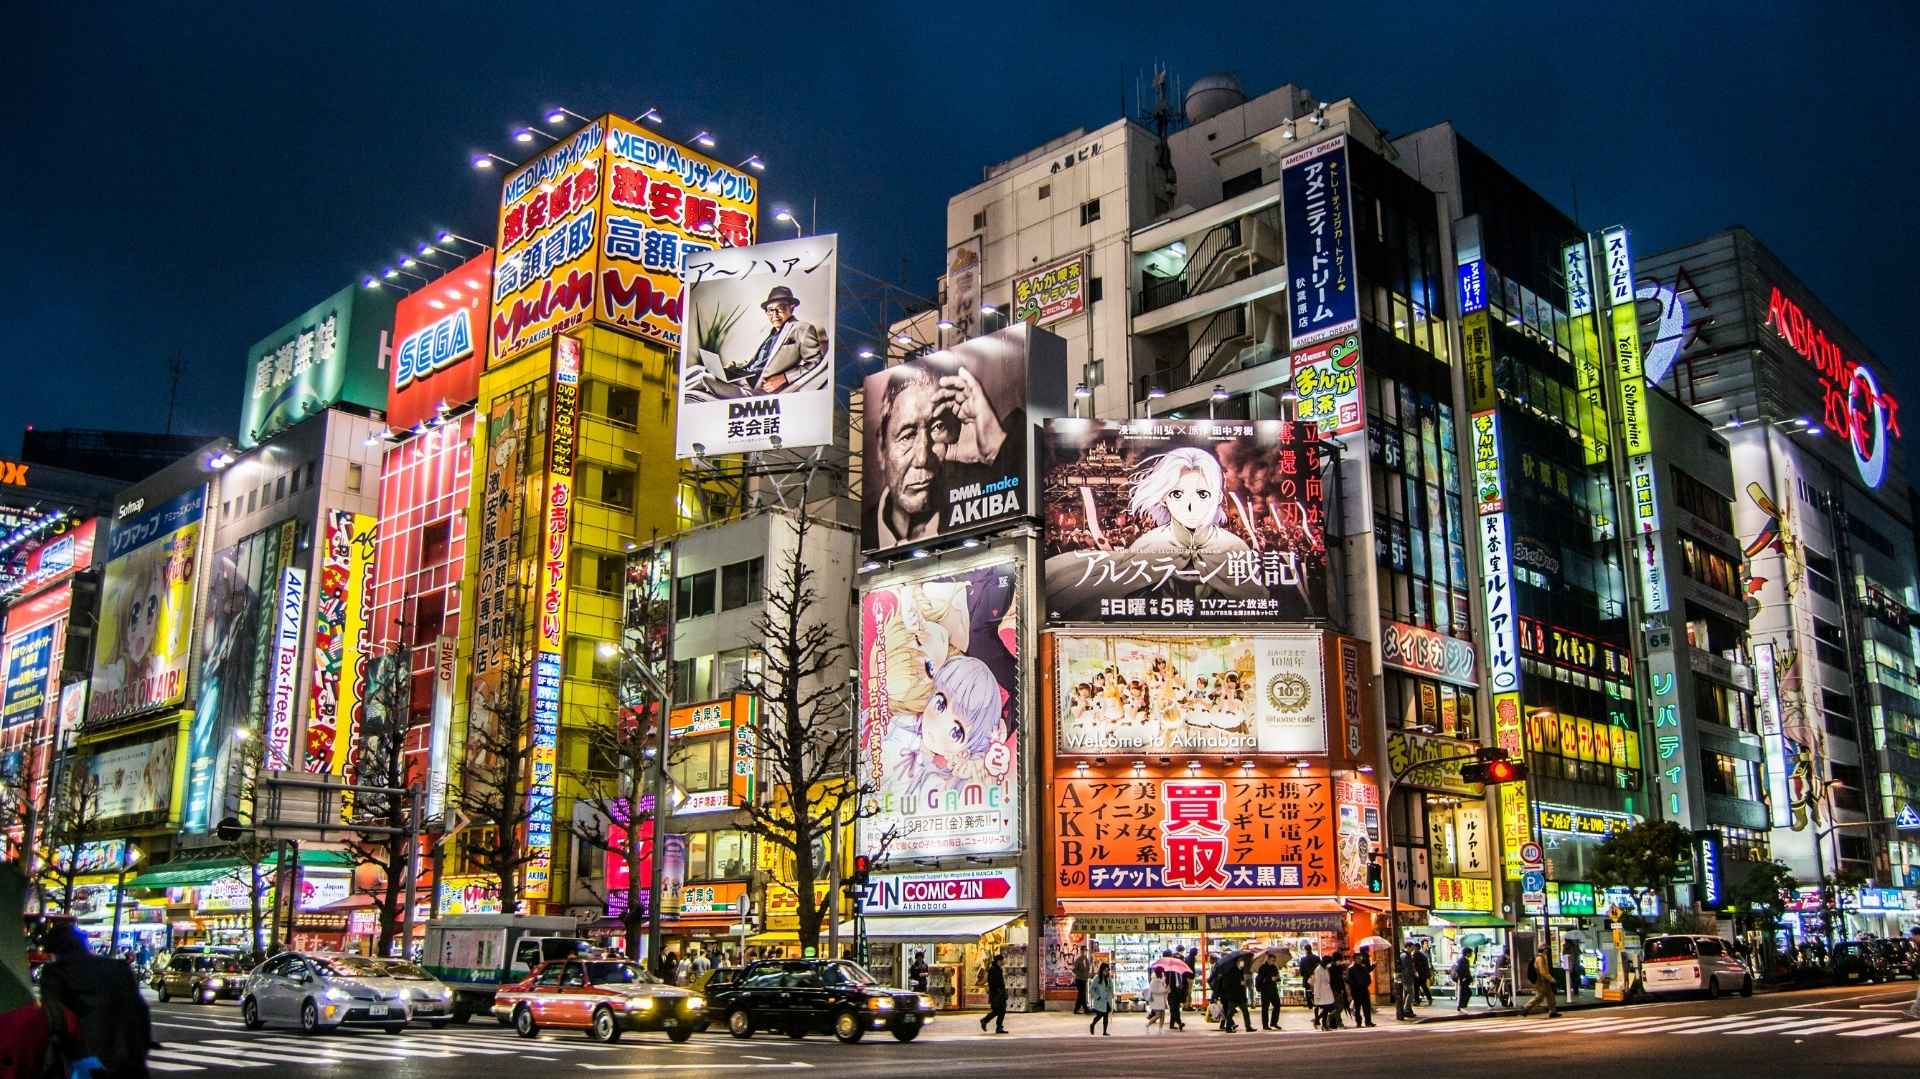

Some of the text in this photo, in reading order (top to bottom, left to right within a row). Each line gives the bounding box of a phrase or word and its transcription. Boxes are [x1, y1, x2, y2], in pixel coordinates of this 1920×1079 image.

[504, 121, 602, 206] MEDIAリサイクル
[612, 129, 753, 203] MEDIAリサイクル
[1285, 139, 1341, 166] AMENITY DREAM
[502, 165, 599, 249] 激安販売
[610, 165, 750, 248] 激安販売
[496, 211, 595, 302] 高額買取
[1303, 161, 1335, 323] アメニティードリーム
[1609, 237, 1628, 299] スーパービル
[395, 307, 473, 390] SEGA
[615, 314, 662, 337] ムーラン
[1295, 323, 1354, 346] AMENITY DREAM
[1618, 335, 1632, 374] Yellow
[557, 385, 577, 397] DVD
[1295, 365, 1357, 396] まんが
[1297, 393, 1337, 419] 喫茶
[727, 416, 780, 439] 英会話
[728, 398, 781, 420] DMM
[1622, 383, 1641, 449] Submarine
[1475, 415, 1494, 460] まんが
[949, 490, 1020, 528] AKIBA
[1074, 548, 1300, 593] アルスラーン戦記
[1486, 516, 1513, 669] 喫茶室 ルノアール
[284, 571, 304, 626] AKKY
[274, 645, 297, 724] Tax-free
[440, 638, 454, 681] GAME
[1343, 648, 1360, 720] 買取
[692, 705, 721, 724] 吉野家
[1067, 730, 1258, 750] Welcome to Akihabara
[736, 725, 748, 776] 吉野家
[1653, 671, 1682, 814] リバティー
[1089, 782, 1110, 861] アイドル
[1112, 782, 1133, 841] アニメ
[1135, 782, 1159, 864] 美少女系
[1162, 782, 1230, 889] 買取
[1232, 782, 1255, 863] フィギュア
[1255, 782, 1277, 841] ホビー
[1278, 782, 1304, 863] 携帯電話
[1303, 782, 1328, 888] アップルとか
[1467, 821, 1480, 869] ルノアール
[1525, 847, 1538, 859] 40
[1702, 839, 1716, 902] GALLERIA
[527, 871, 548, 880] AKIBA
[684, 887, 714, 905] 吉野家
[866, 876, 899, 910] ZIN
[904, 880, 983, 901] COMIC ZIN
[1091, 867, 1160, 888] チケット
[1234, 866, 1300, 887] 大黒屋
